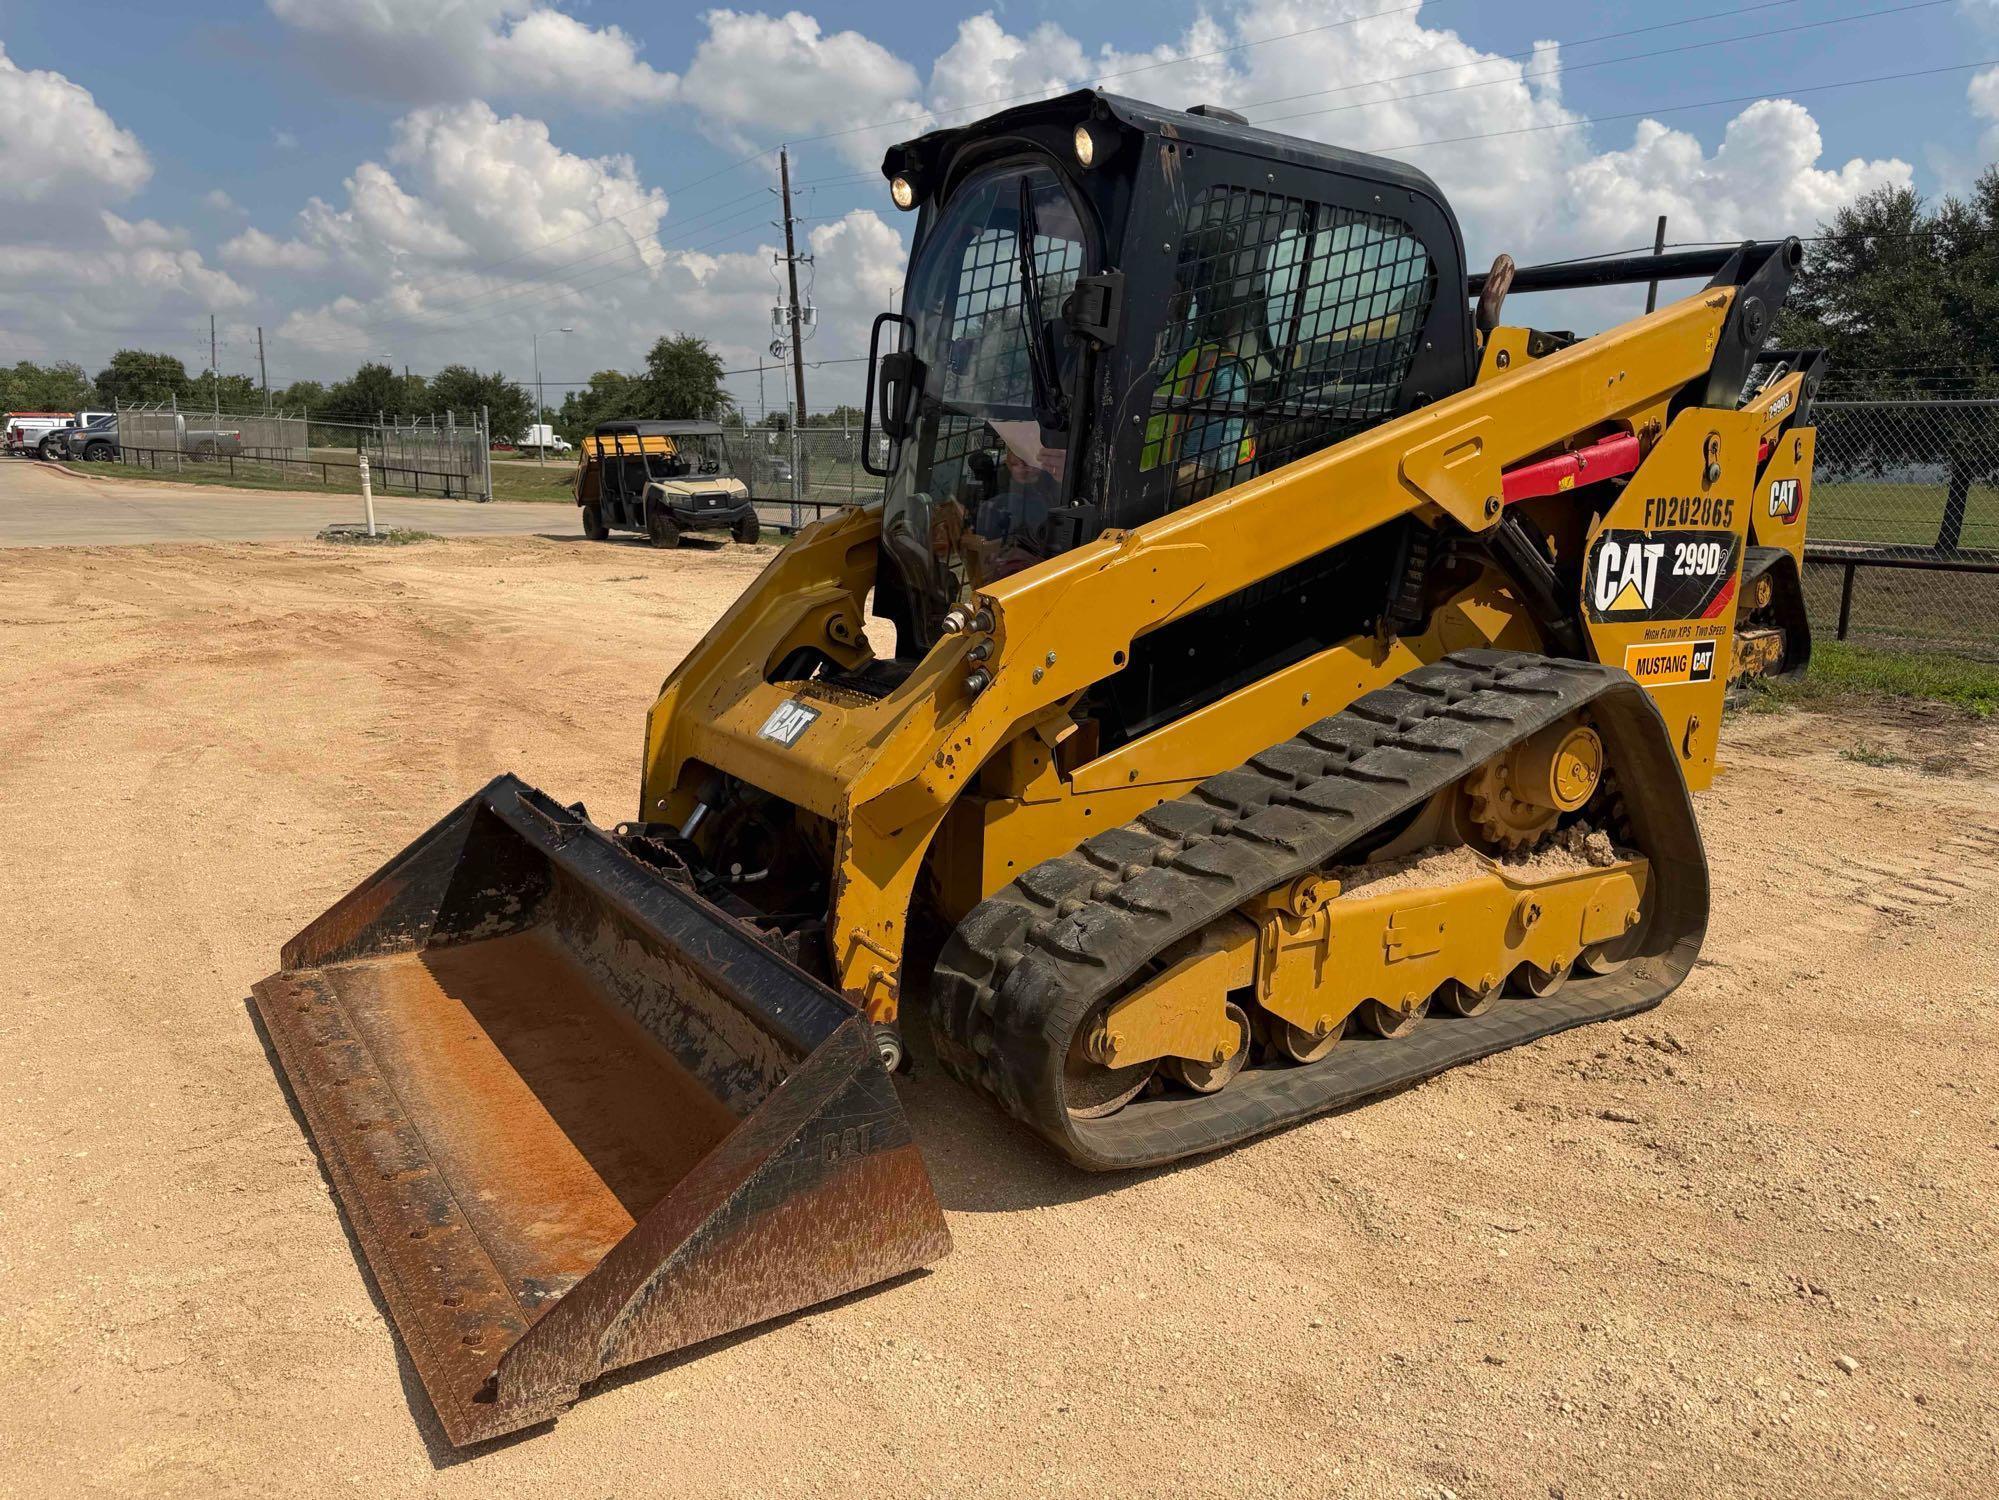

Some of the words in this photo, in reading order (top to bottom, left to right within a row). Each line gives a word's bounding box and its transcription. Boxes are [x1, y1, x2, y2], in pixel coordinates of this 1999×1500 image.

[1644, 496, 1735, 528] FD202865
[1769, 480, 1797, 517] CAT
[1594, 541, 1665, 611] CAT
[1672, 542, 1729, 576] 299D2
[1677, 625, 1692, 638] XPS
[1635, 654, 1688, 676] MUSTANG
[1692, 651, 1712, 672] CAT
[763, 703, 815, 744] CAT
[821, 1122, 874, 1168] CAT
